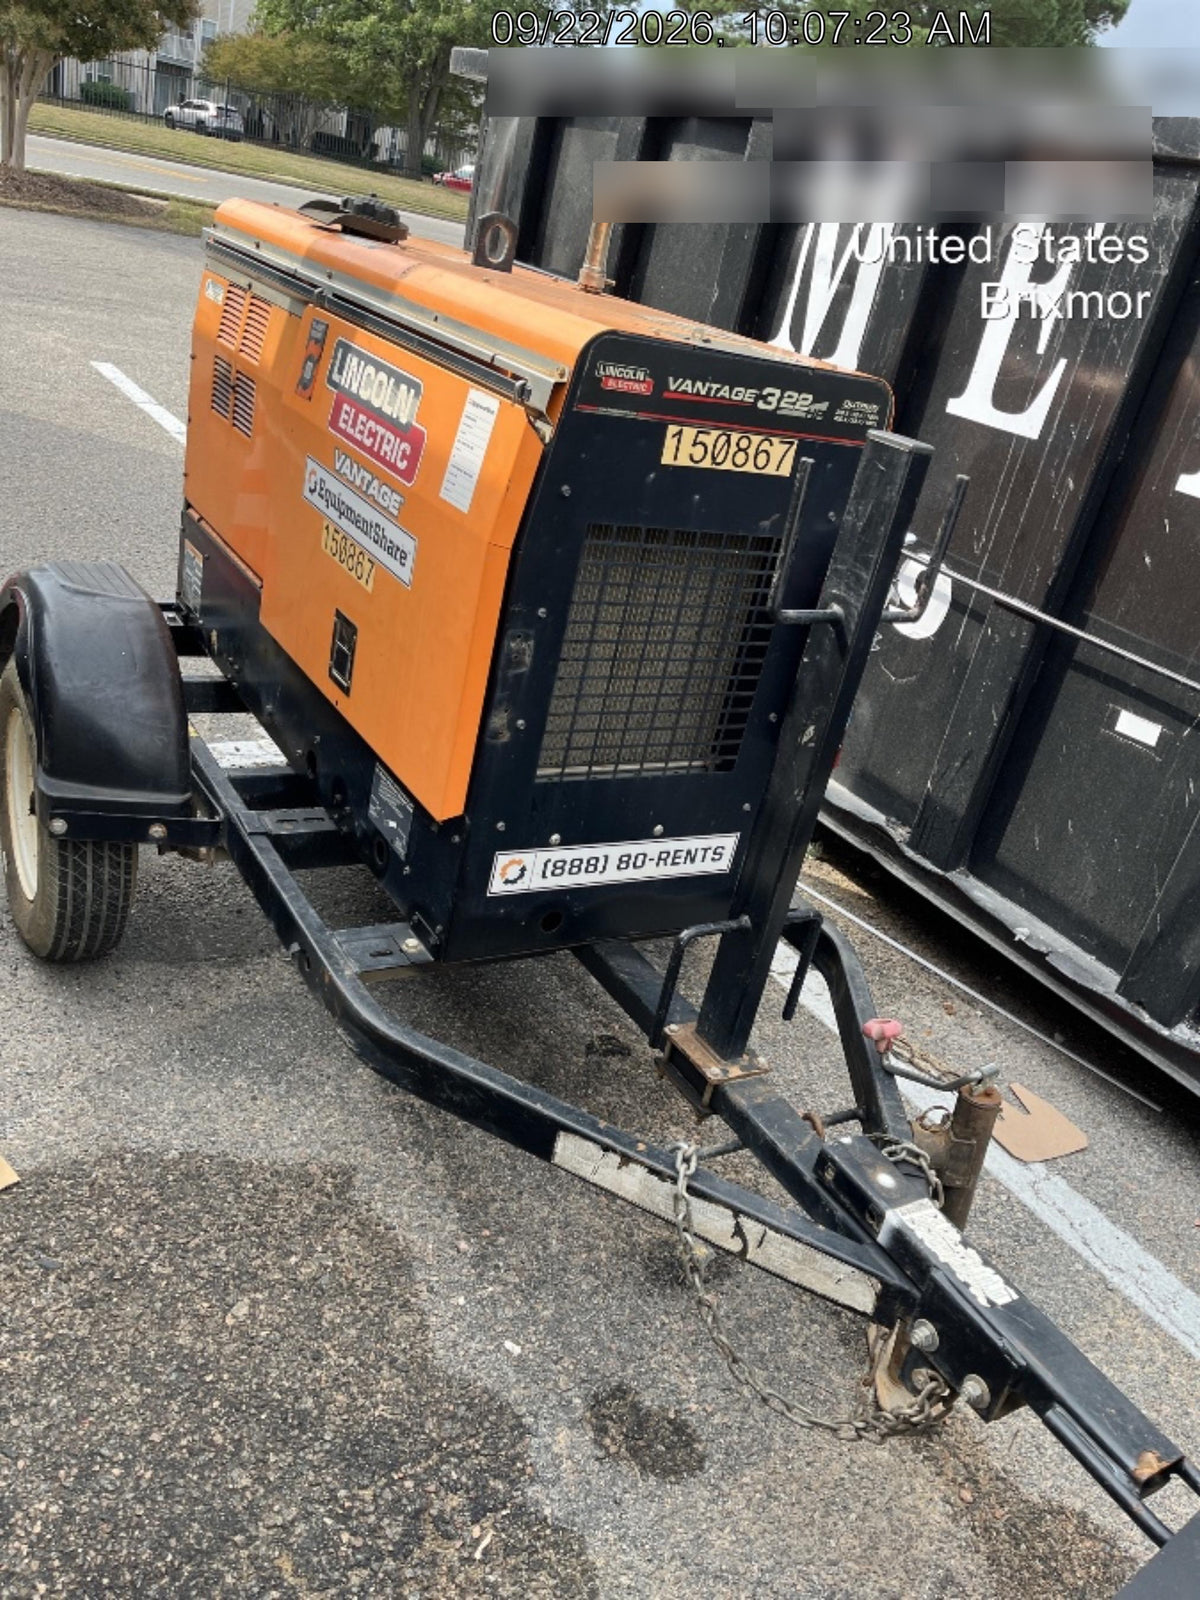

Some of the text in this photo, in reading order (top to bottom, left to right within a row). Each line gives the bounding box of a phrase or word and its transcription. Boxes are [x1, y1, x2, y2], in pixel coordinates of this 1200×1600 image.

[331, 348, 416, 425] LINCOLN
[600, 363, 646, 381] LINCOLN
[667, 376, 814, 411] VANTAGE 322
[338, 403, 411, 470] ELECTRIC
[670, 429, 796, 473] 150867
[333, 448, 404, 518] VANTAGE
[317, 477, 409, 568] EquipmentShare
[323, 523, 376, 586] 150867
[541, 846, 726, 879] (888) 80-RENTS
